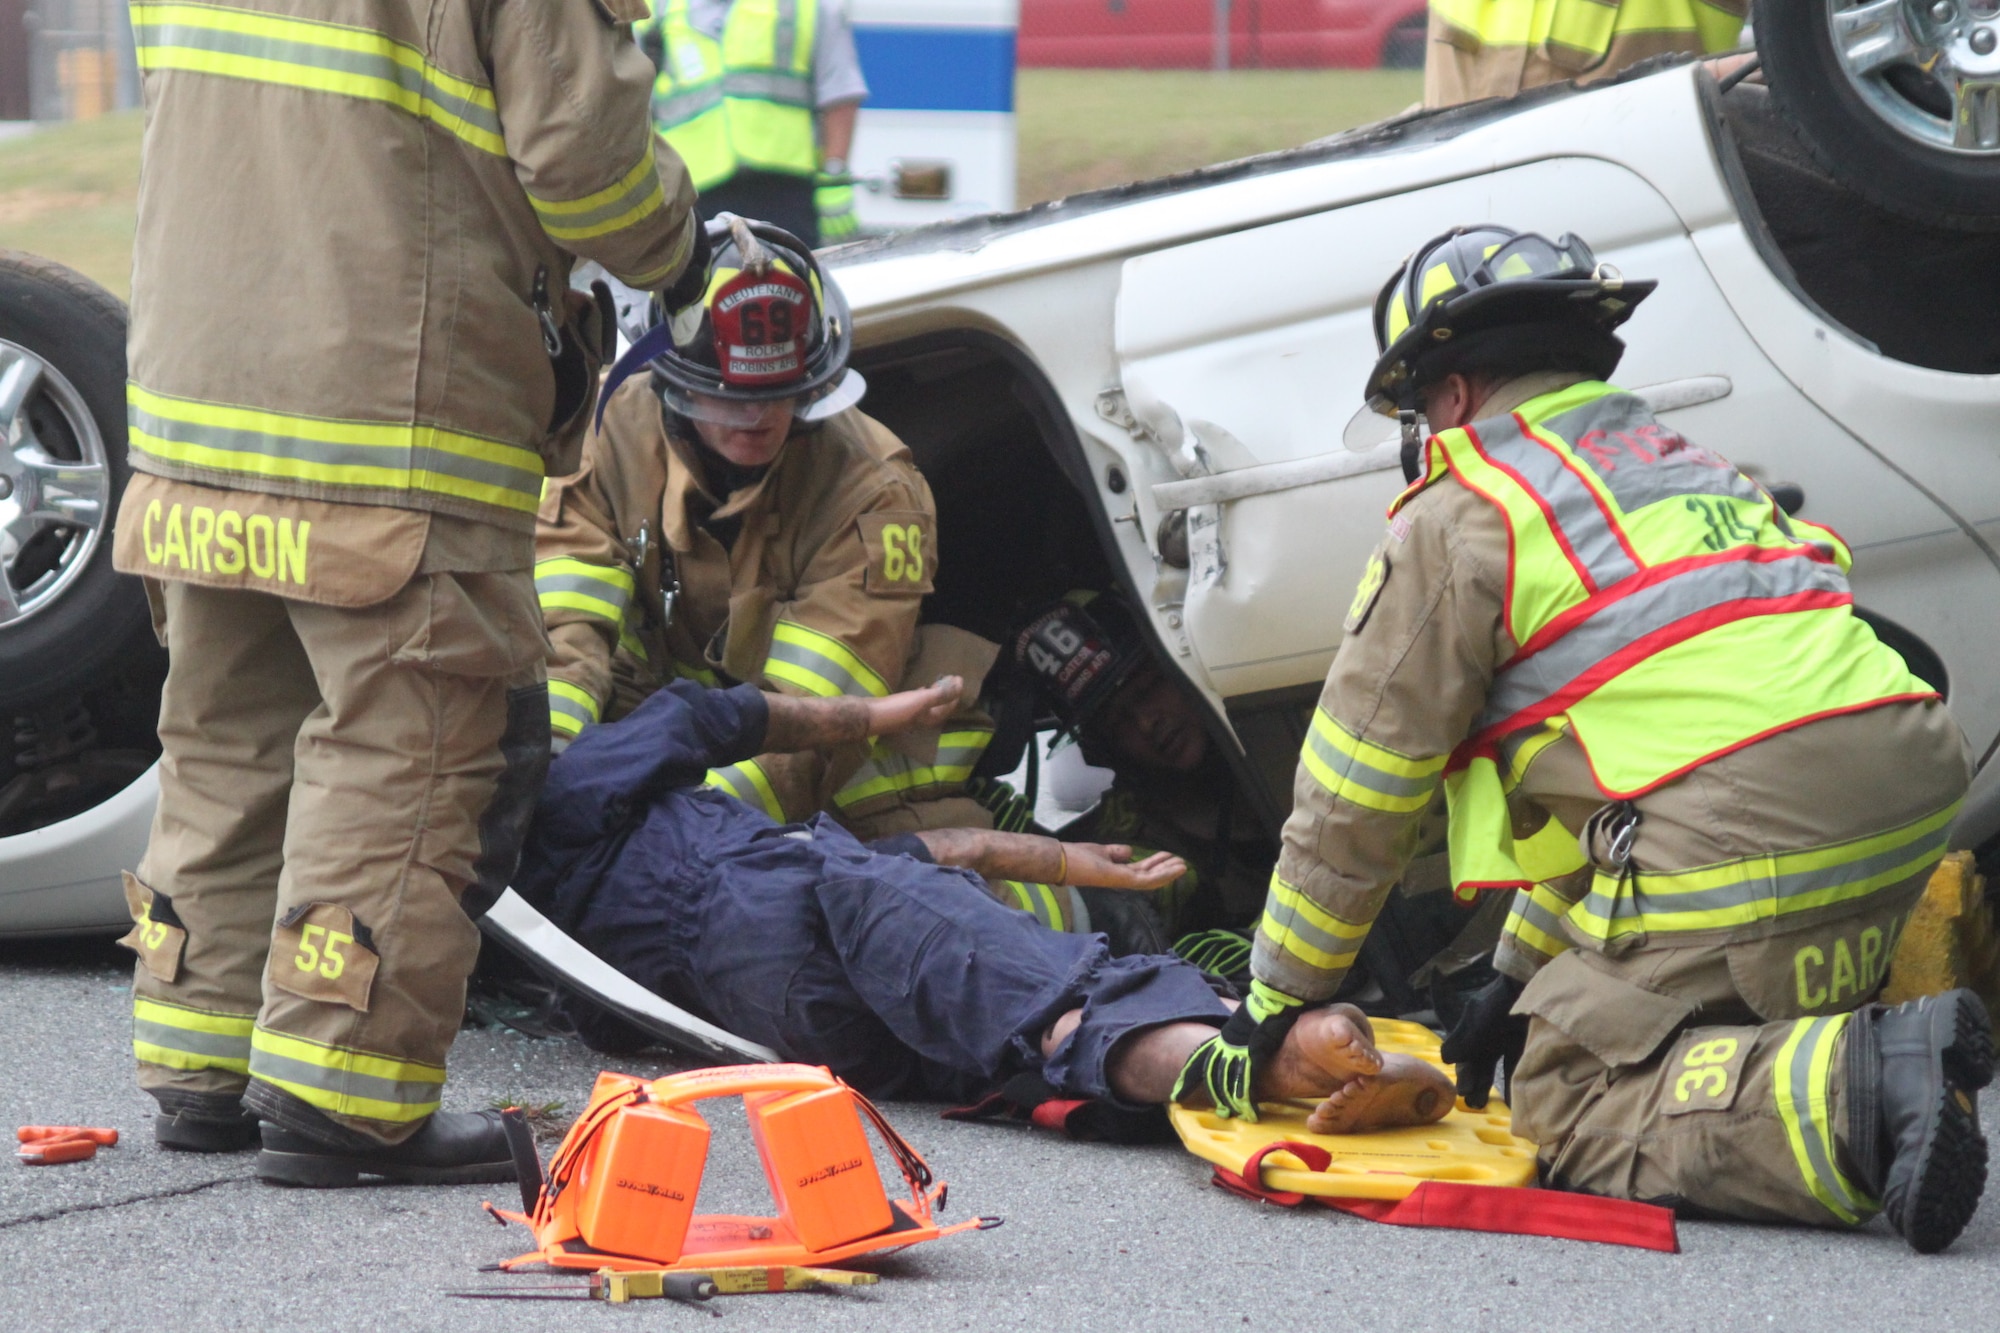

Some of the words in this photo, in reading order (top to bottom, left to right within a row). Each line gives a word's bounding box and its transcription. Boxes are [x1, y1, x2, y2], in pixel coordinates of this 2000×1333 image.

[722, 283, 801, 310] LIEUTENANT
[741, 300, 791, 346] 69
[731, 361, 775, 374] ROBINS
[779, 359, 797, 370] AFB
[745, 343, 785, 357] ROLPH
[143, 498, 311, 585] CARSON
[881, 523, 923, 582] 69
[1028, 620, 1080, 676] 46
[295, 923, 354, 980] 55
[1794, 908, 1910, 1009] CAR
[1675, 1037, 1738, 1102] 38
